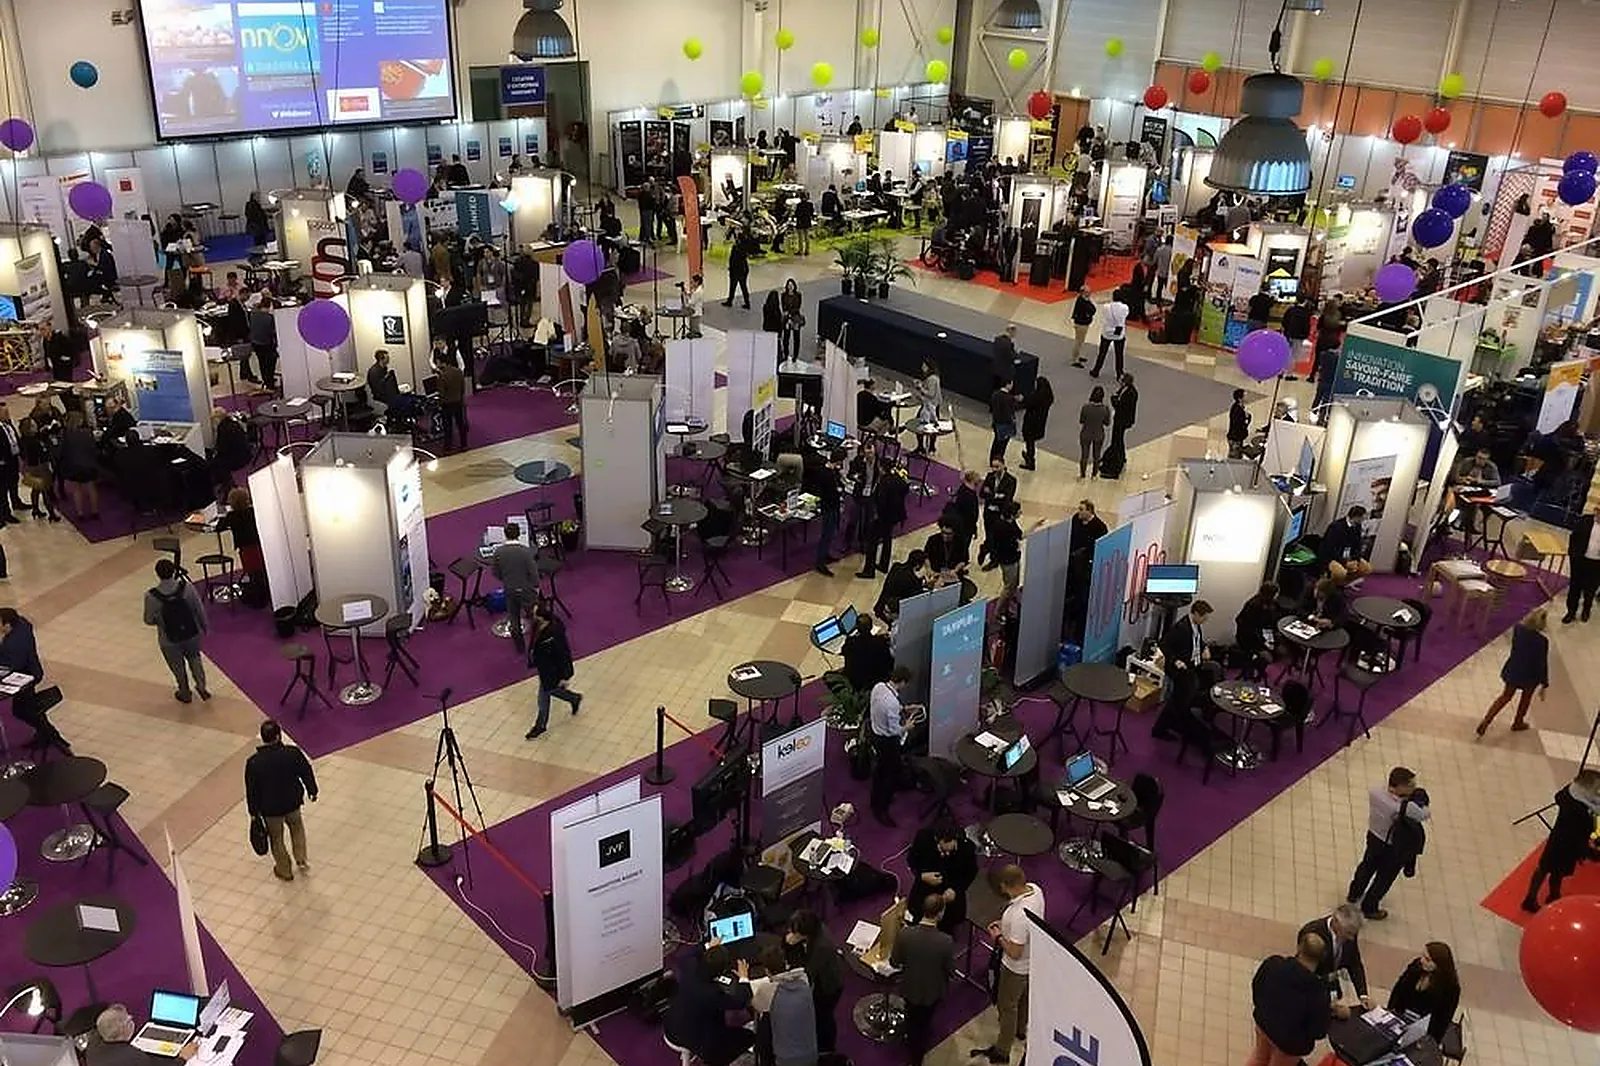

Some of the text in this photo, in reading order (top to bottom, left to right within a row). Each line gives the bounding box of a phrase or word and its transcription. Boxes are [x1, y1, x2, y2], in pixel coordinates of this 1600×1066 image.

[1345, 360, 1414, 385] SAVOIR-FAIRE
[1347, 349, 1406, 373] INNOVATION
[1353, 372, 1406, 393] TRADITION
[1052, 1024, 1100, 1066] E
